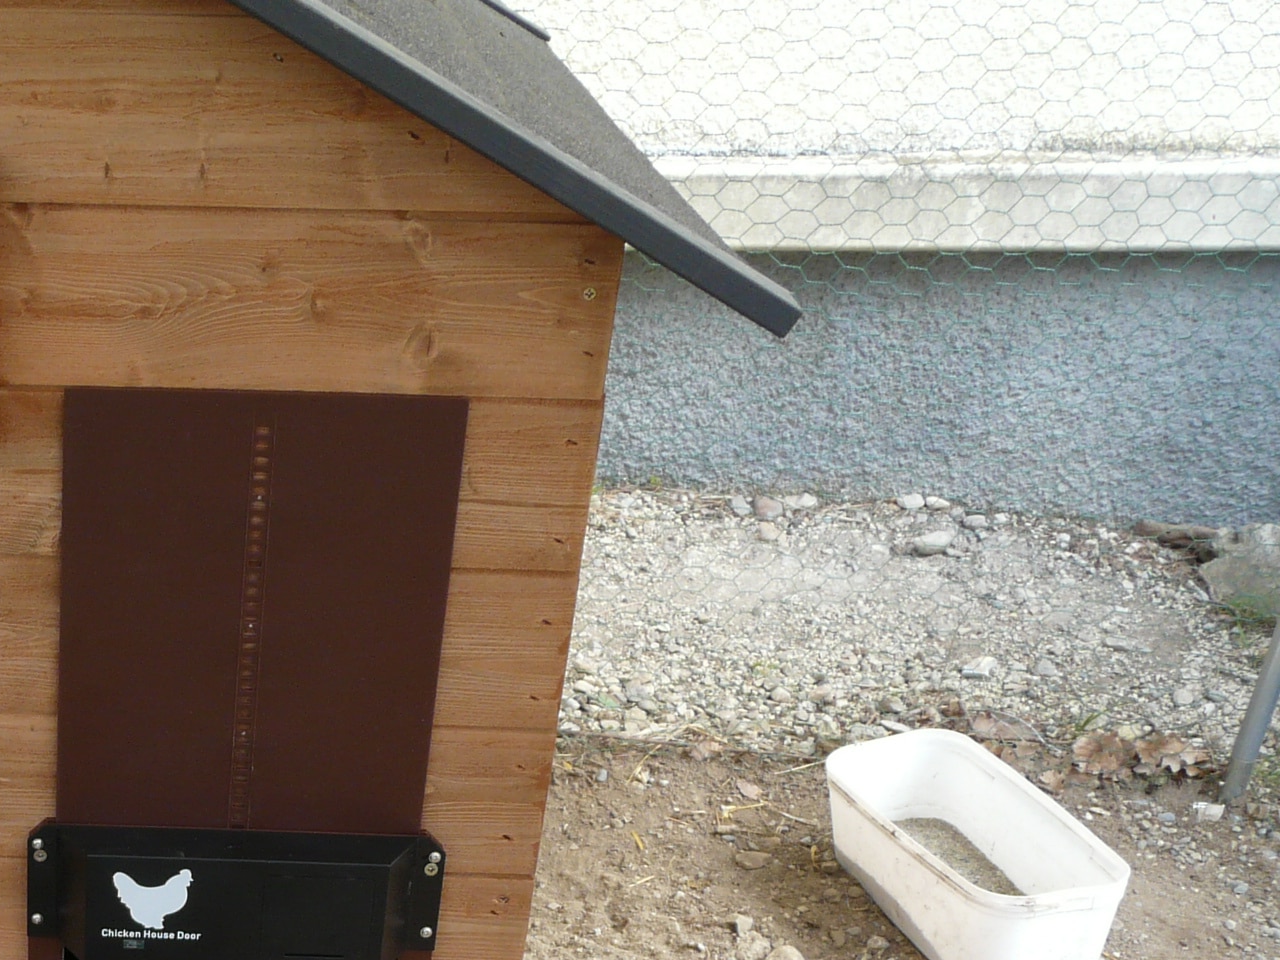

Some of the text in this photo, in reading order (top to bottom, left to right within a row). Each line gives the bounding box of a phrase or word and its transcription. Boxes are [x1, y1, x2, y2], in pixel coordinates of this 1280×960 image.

[101, 928, 202, 940] Chicken House Door
